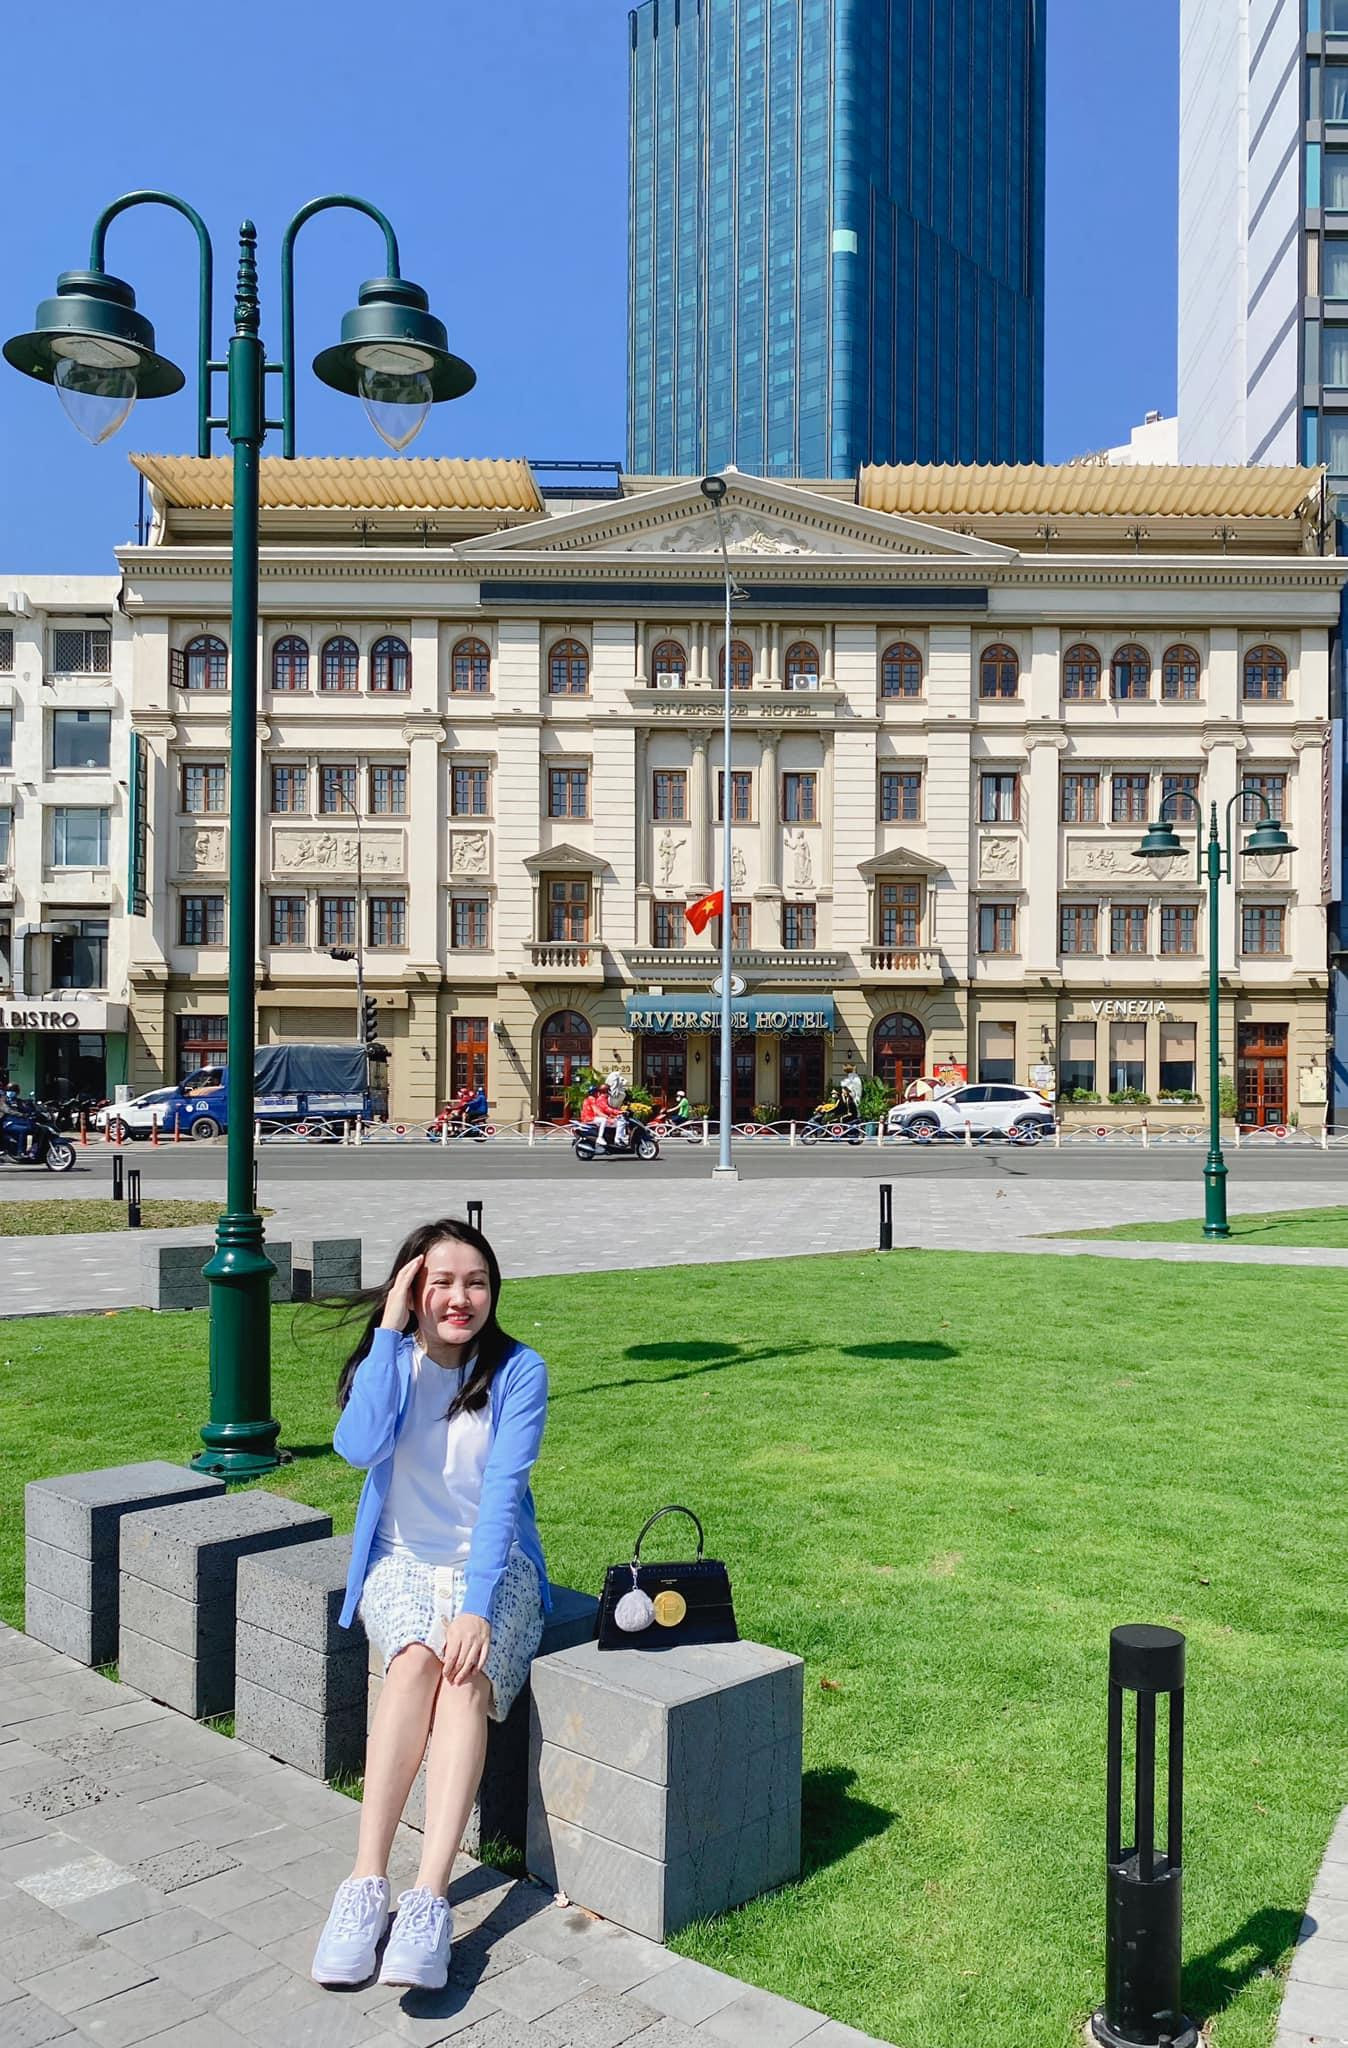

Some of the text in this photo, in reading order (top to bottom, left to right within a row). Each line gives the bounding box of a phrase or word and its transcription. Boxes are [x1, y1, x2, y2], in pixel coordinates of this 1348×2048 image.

[760, 704, 818, 717] HOTEL
[1091, 1000, 1167, 1014] VENEZIA
[11, 1011, 79, 1028] BISTRO
[755, 1011, 828, 1029] HOTEL
